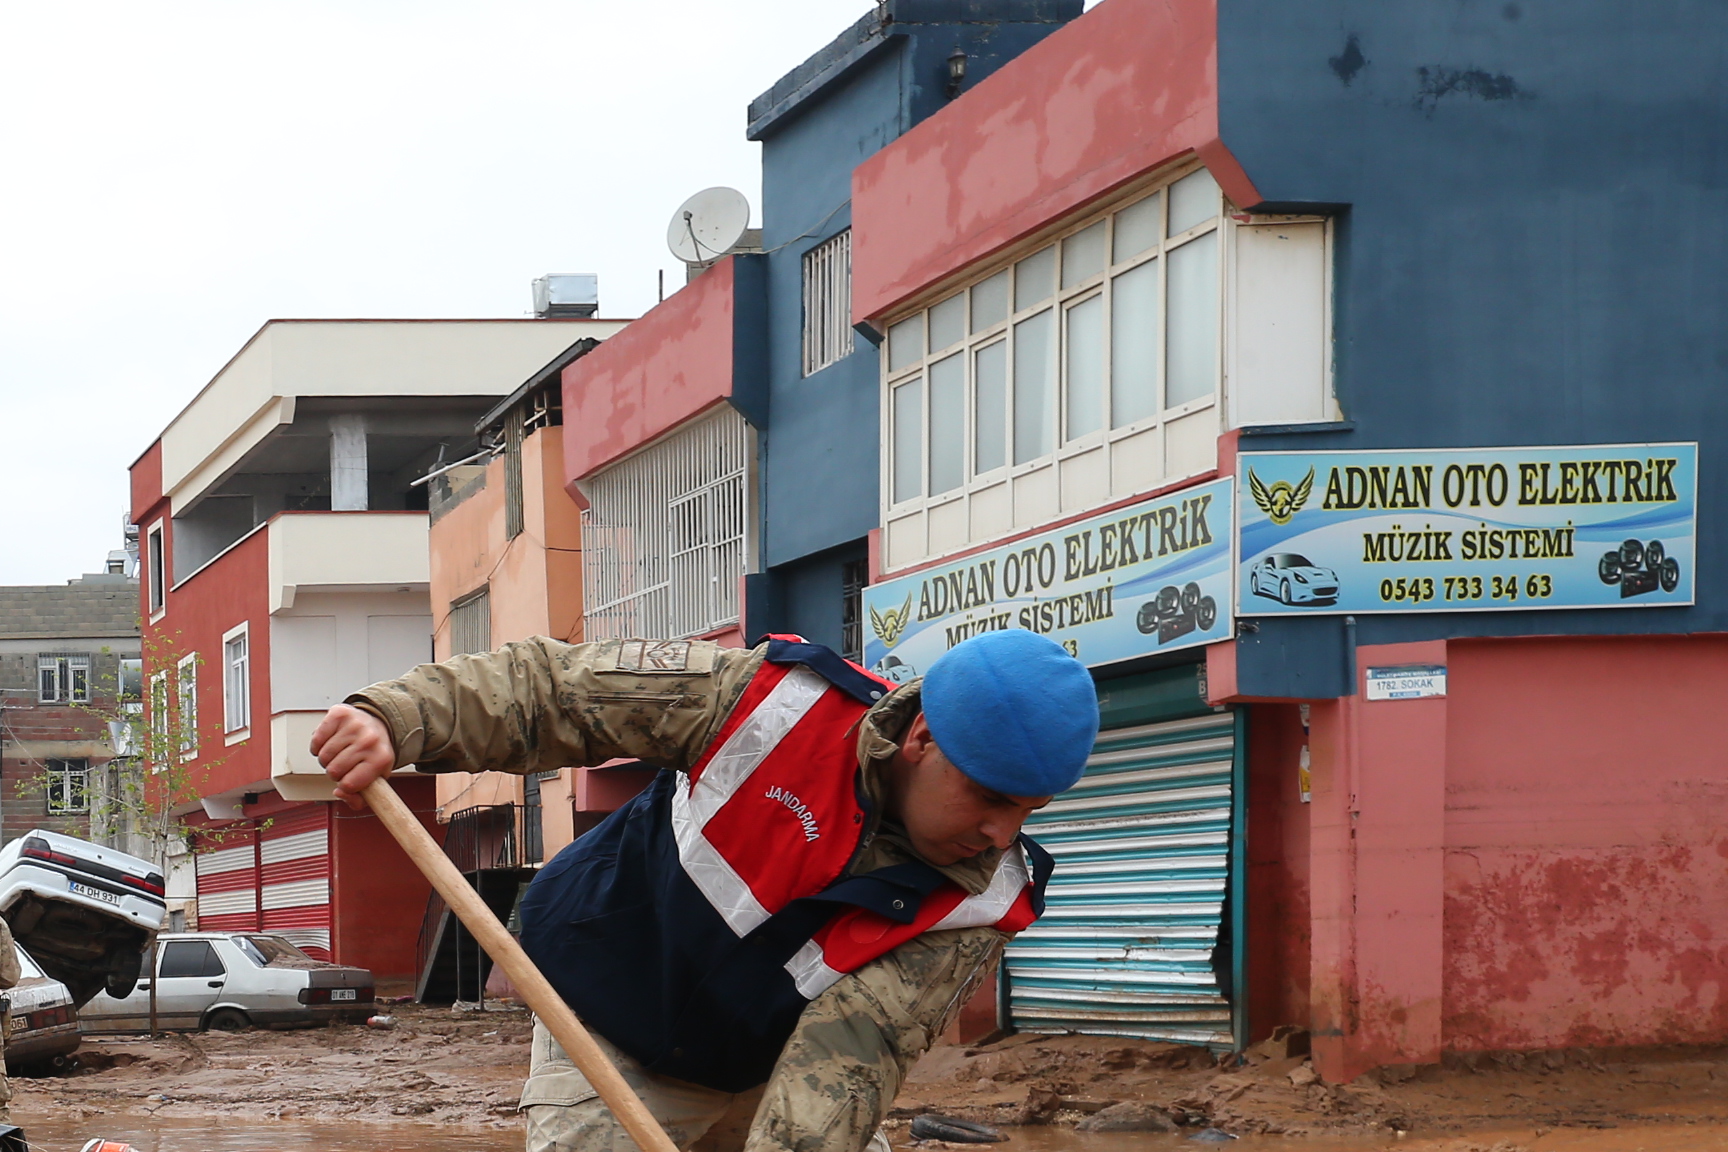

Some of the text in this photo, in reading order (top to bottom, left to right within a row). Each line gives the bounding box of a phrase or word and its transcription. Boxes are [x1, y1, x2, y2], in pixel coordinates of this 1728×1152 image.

[1322, 464, 1434, 510] ADNAN
[1442, 462, 1509, 508] OTO
[1362, 520, 1575, 563] MÜZİK SİSTEMİ
[917, 559, 996, 622] ADNAN
[1003, 542, 1056, 598] OTO
[1380, 574, 1553, 603] 0543 733 34 63
[1018, 576, 1115, 635] SİSTEMİ
[1401, 679, 1434, 690] SOKAK
[765, 785, 820, 842] JANDARMA
[74, 884, 118, 905] 44 DH 931
